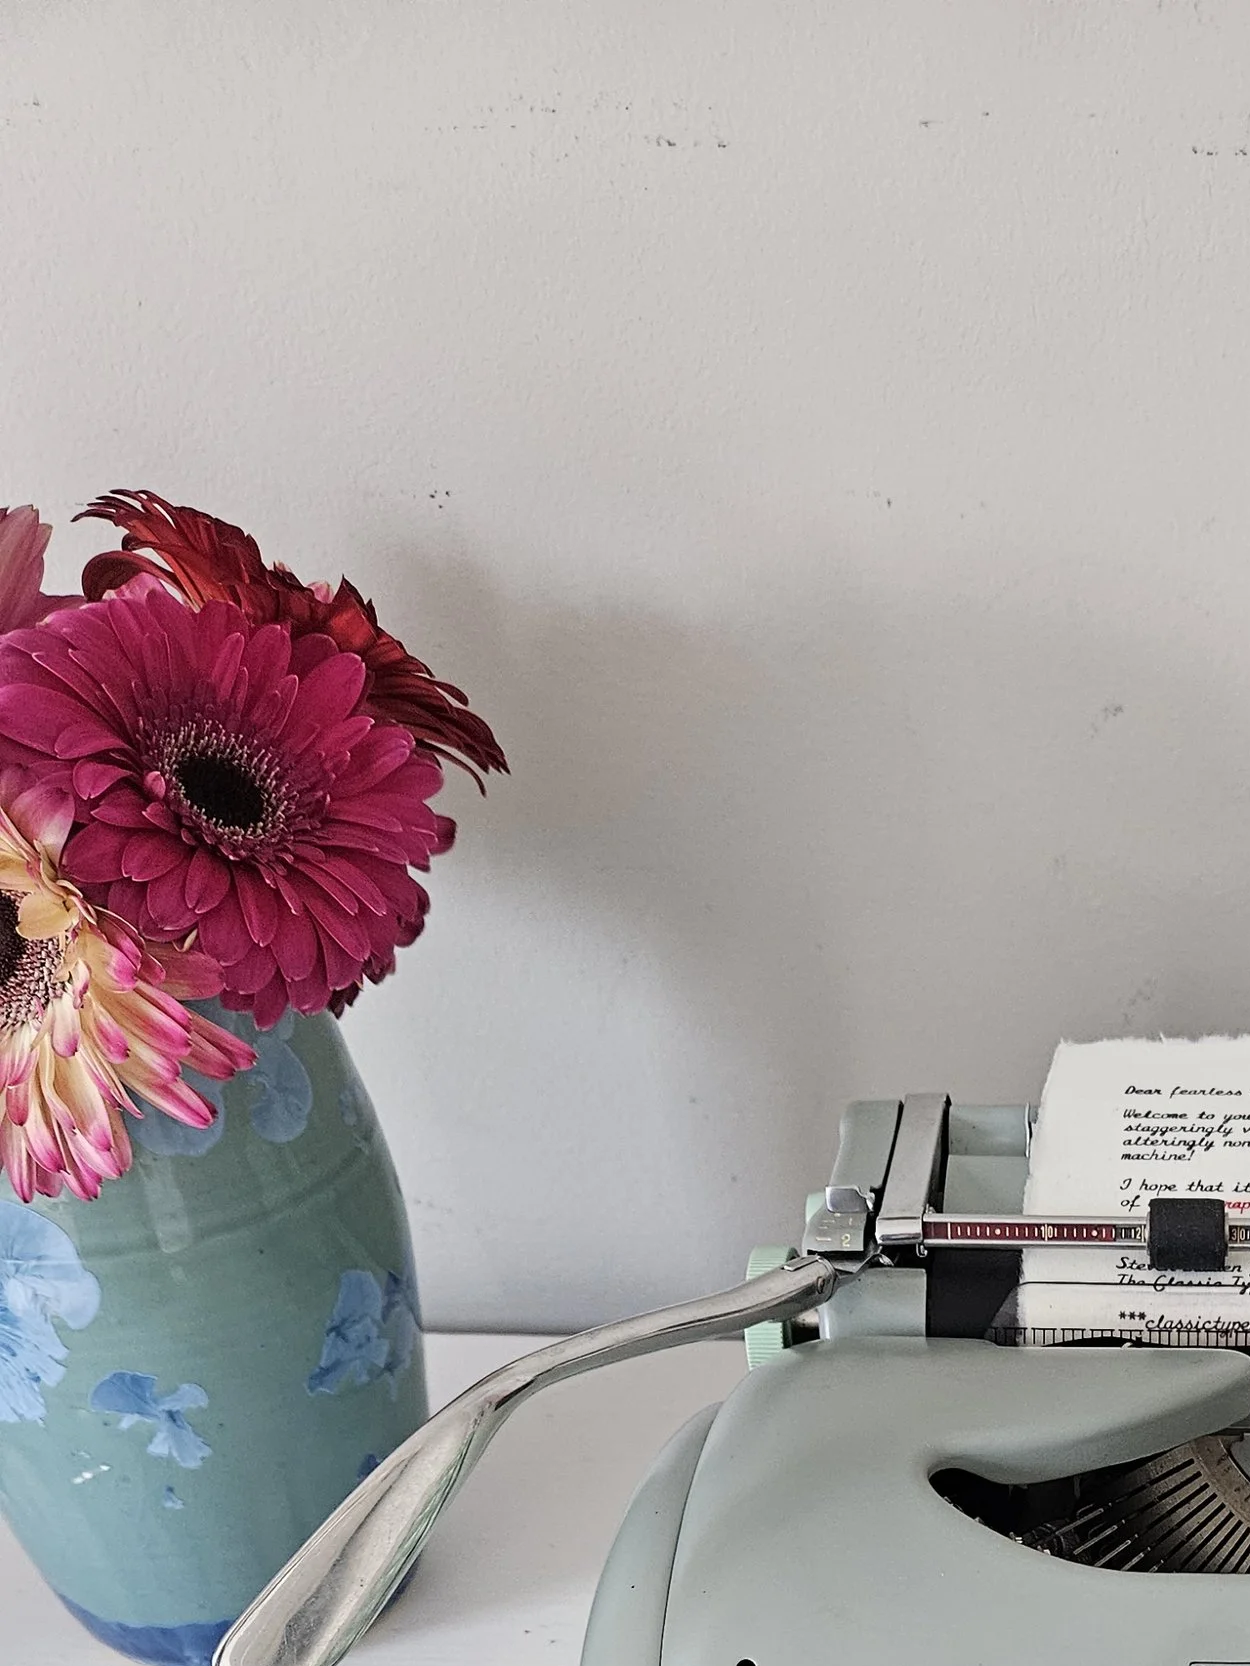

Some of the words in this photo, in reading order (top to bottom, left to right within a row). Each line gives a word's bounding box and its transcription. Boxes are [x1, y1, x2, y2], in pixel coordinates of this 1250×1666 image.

[1124, 1085, 1162, 1096] Dear
[1169, 1086, 1243, 1099] fearless
[1122, 1108, 1188, 1119] Welcome
[1197, 1111, 1215, 1120] to
[1123, 1123, 1233, 1138] staggeringly
[1122, 1136, 1215, 1152] alteringly
[1120, 1149, 1195, 1161] machine!
[1119, 1178, 1132, 1191] I
[1139, 1178, 1177, 1196] hope
[1185, 1180, 1224, 1192] that
[1120, 1194, 1141, 1212] of
[841, 1233, 851, 1247] 2
[1118, 1273, 1146, 1286] The
